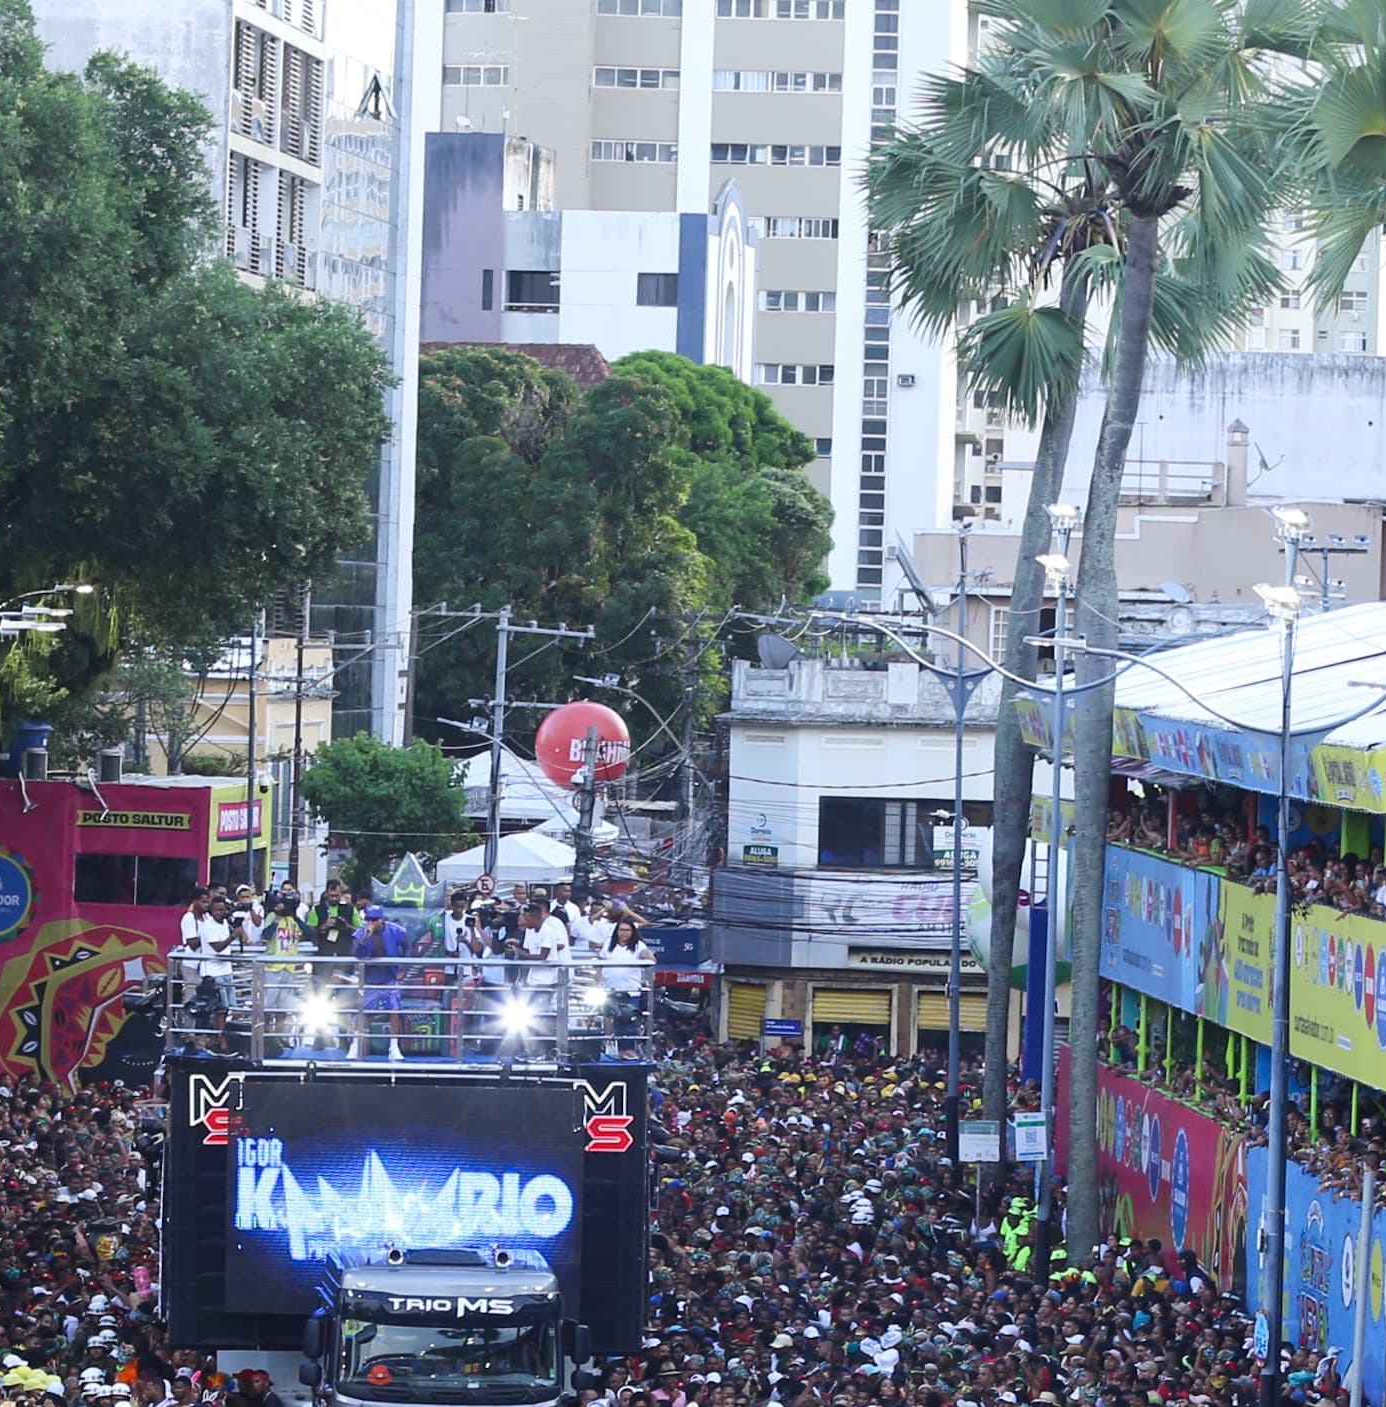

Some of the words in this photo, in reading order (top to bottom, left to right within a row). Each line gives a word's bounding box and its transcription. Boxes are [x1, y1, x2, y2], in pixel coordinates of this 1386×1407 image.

[82, 812, 129, 825] POSTO
[131, 813, 184, 827] SALTUR
[860, 957, 868, 965] A
[871, 954, 905, 966] RÁDIO
[907, 957, 955, 968] POPULA
[387, 1297, 452, 1313] TRIO
[456, 1296, 515, 1318] MS
